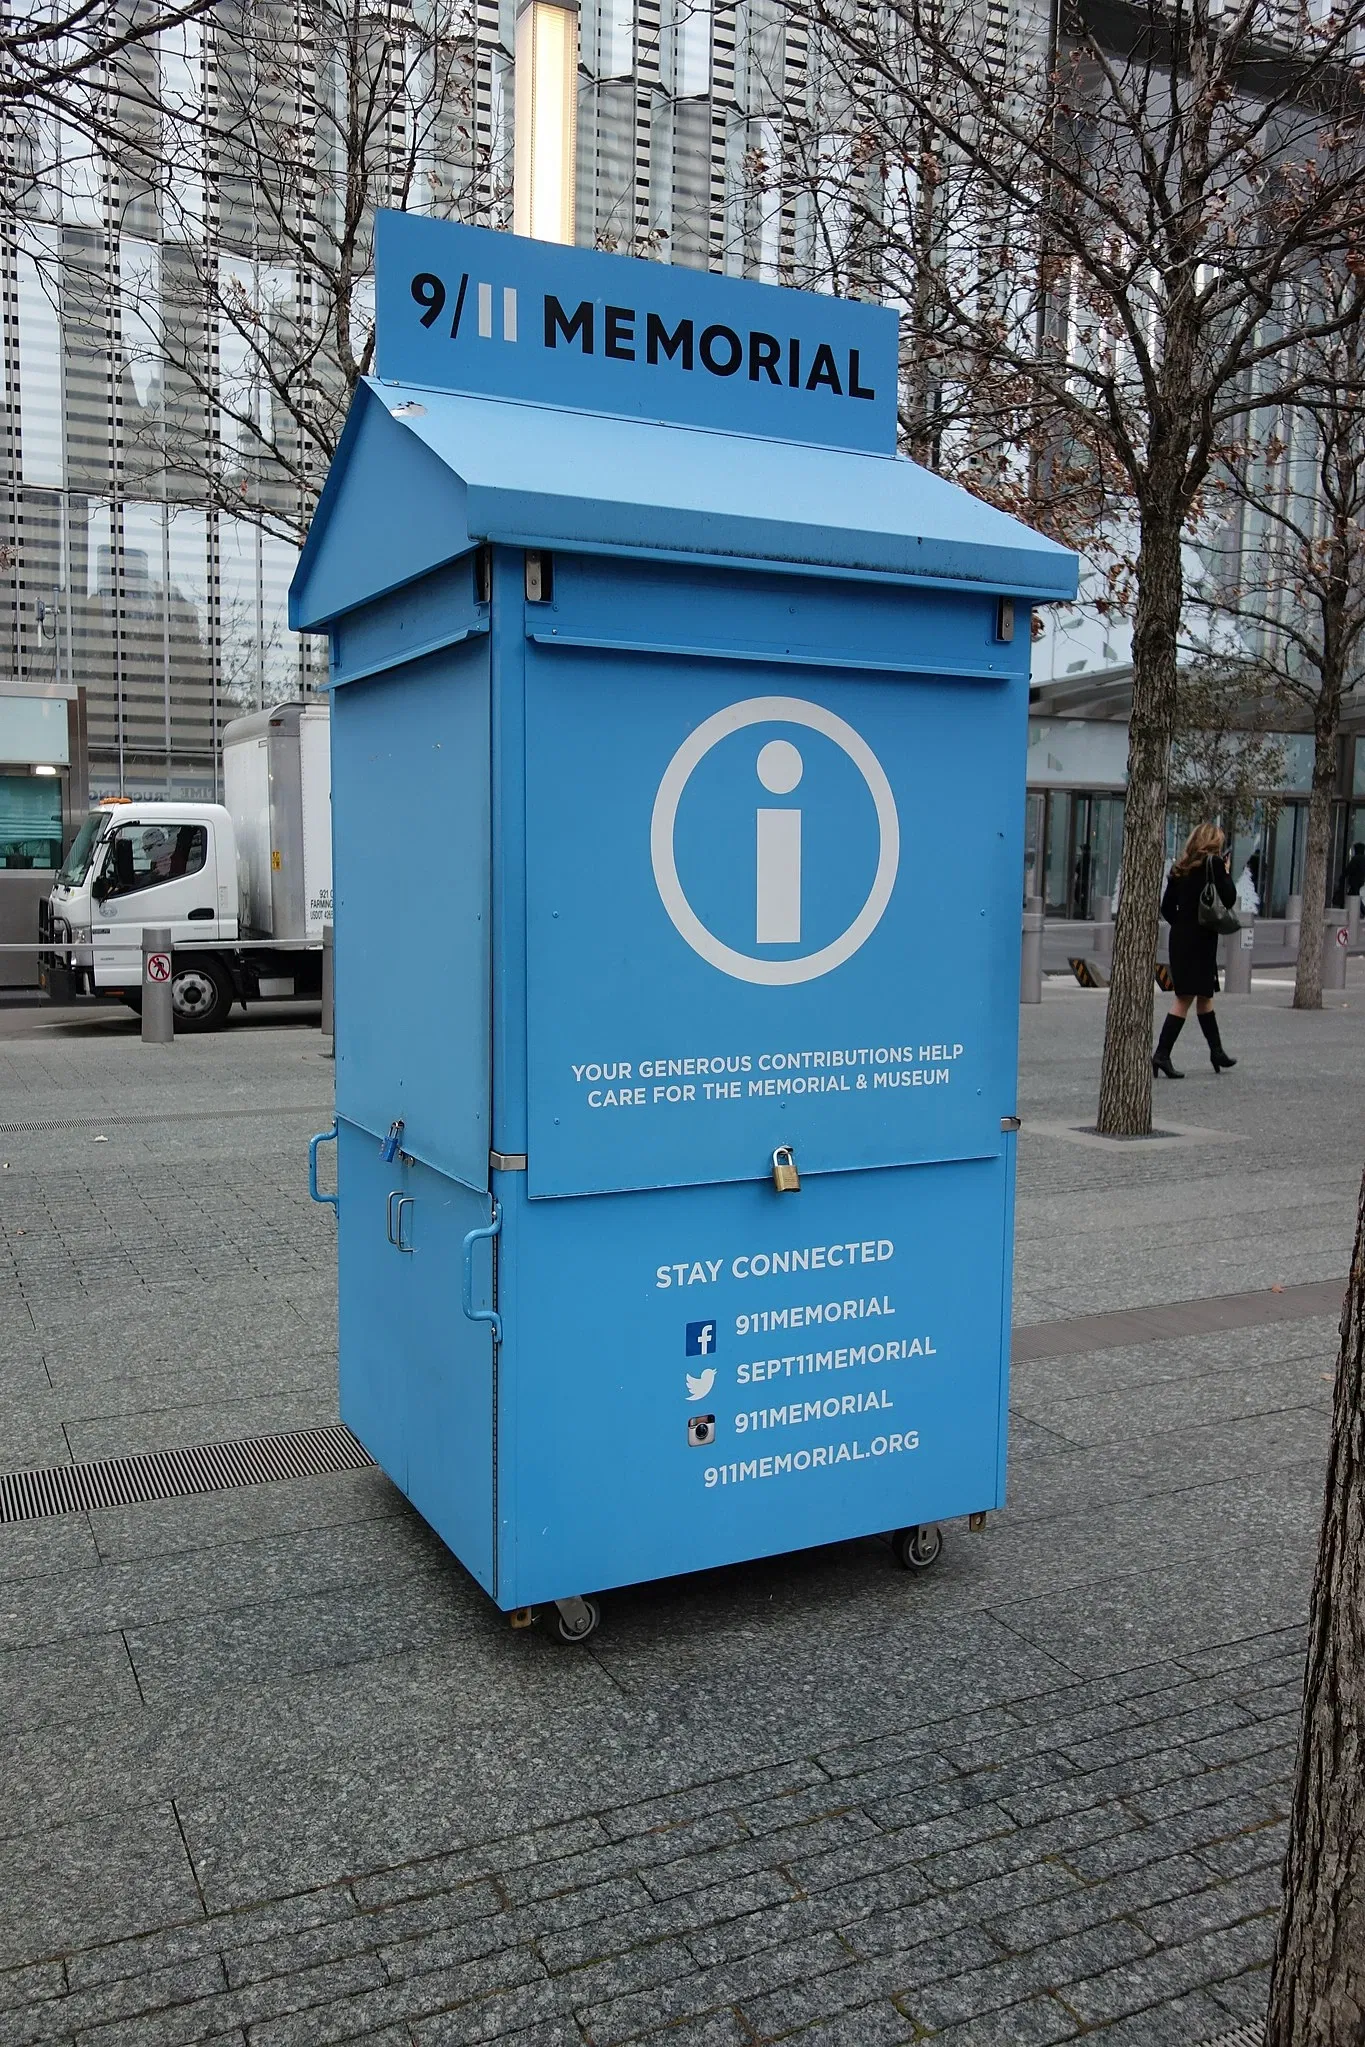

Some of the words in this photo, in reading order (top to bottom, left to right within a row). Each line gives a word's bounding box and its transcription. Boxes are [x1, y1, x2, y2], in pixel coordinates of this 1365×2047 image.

[411, 272, 518, 342] 9/11
[544, 295, 875, 401] MEMORIAL
[571, 1062, 632, 1082] YOUR
[638, 1056, 752, 1078] GENEROUS
[758, 1046, 914, 1071] CONTRIBUTIONS
[918, 1043, 964, 1063] HELP
[587, 1087, 647, 1108] CARE
[653, 1084, 696, 1104] FOR
[702, 1081, 742, 1100] THE
[748, 1075, 851, 1097] MEMORIAL
[855, 1073, 868, 1090] &
[873, 1068, 950, 1090] MUSEUM
[656, 1259, 724, 1289] STAY
[731, 1239, 894, 1279] CONNECTED
[735, 1295, 896, 1336] 911MEMORIAL
[736, 1336, 937, 1384] SEPT11MEMORIAL
[734, 1389, 894, 1434] 911MEMORIAL
[703, 1430, 919, 1488] 911MEMORIAL.ORG
